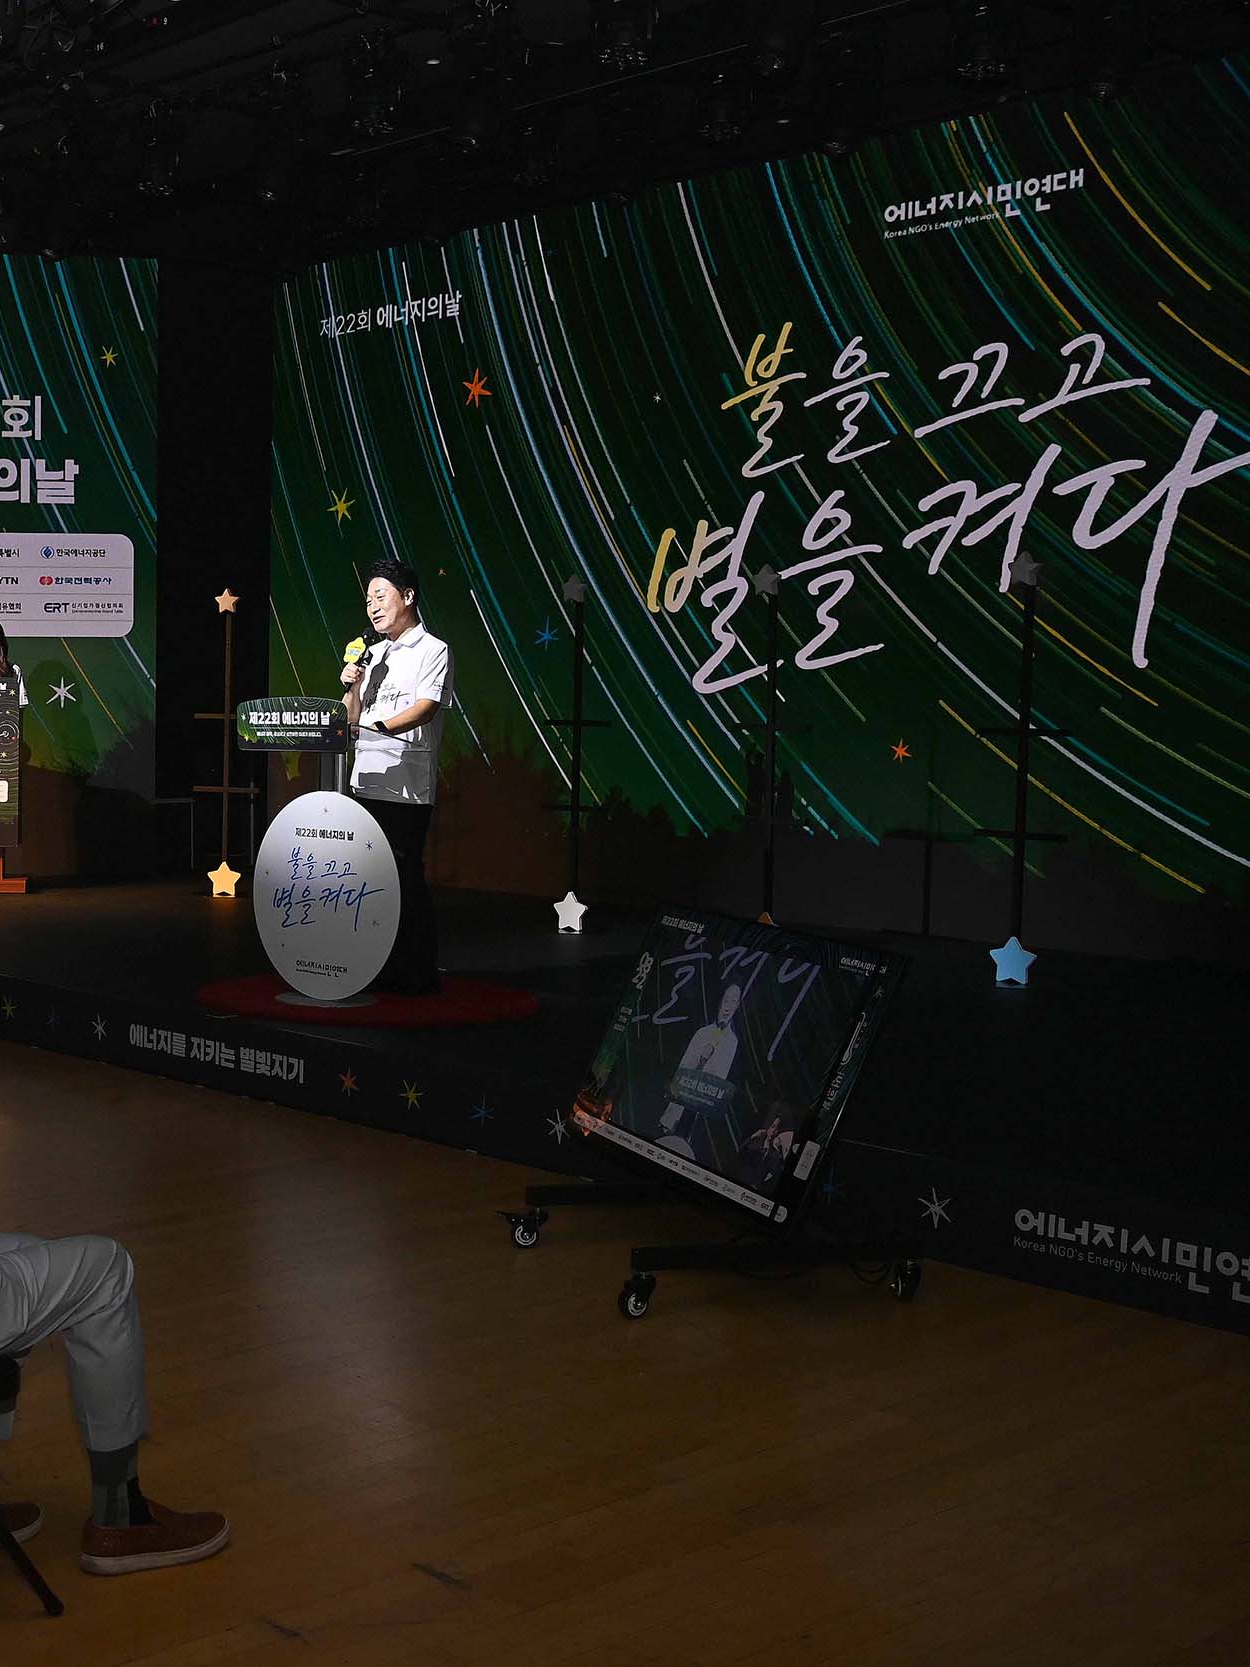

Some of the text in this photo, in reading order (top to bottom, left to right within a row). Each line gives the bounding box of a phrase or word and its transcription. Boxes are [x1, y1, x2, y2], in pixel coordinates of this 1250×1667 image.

[884, 168, 1085, 223] 에너지시민연대
[884, 211, 1001, 239] Korea NGO's Energy Network
[320, 290, 463, 338] 제22회 에너지의날
[721, 322, 1151, 478] 불을 끄고
[56, 548, 107, 558] 한국에너지공단
[647, 409, 1250, 694] 별을 켜다
[54, 576, 112, 586] 한국전력공사
[44, 602, 70, 613] ERT
[249, 711, 330, 726] 제22회 에너지의 날
[294, 827, 355, 841] 제22회 에너지의 날
[287, 846, 358, 880] 불을 끄고
[271, 880, 385, 932] 별을 켜다
[129, 1023, 305, 1084] 에너지를 지키는 별빛지기
[1013, 1236, 1183, 1284] Korea NGO's Energy Network
